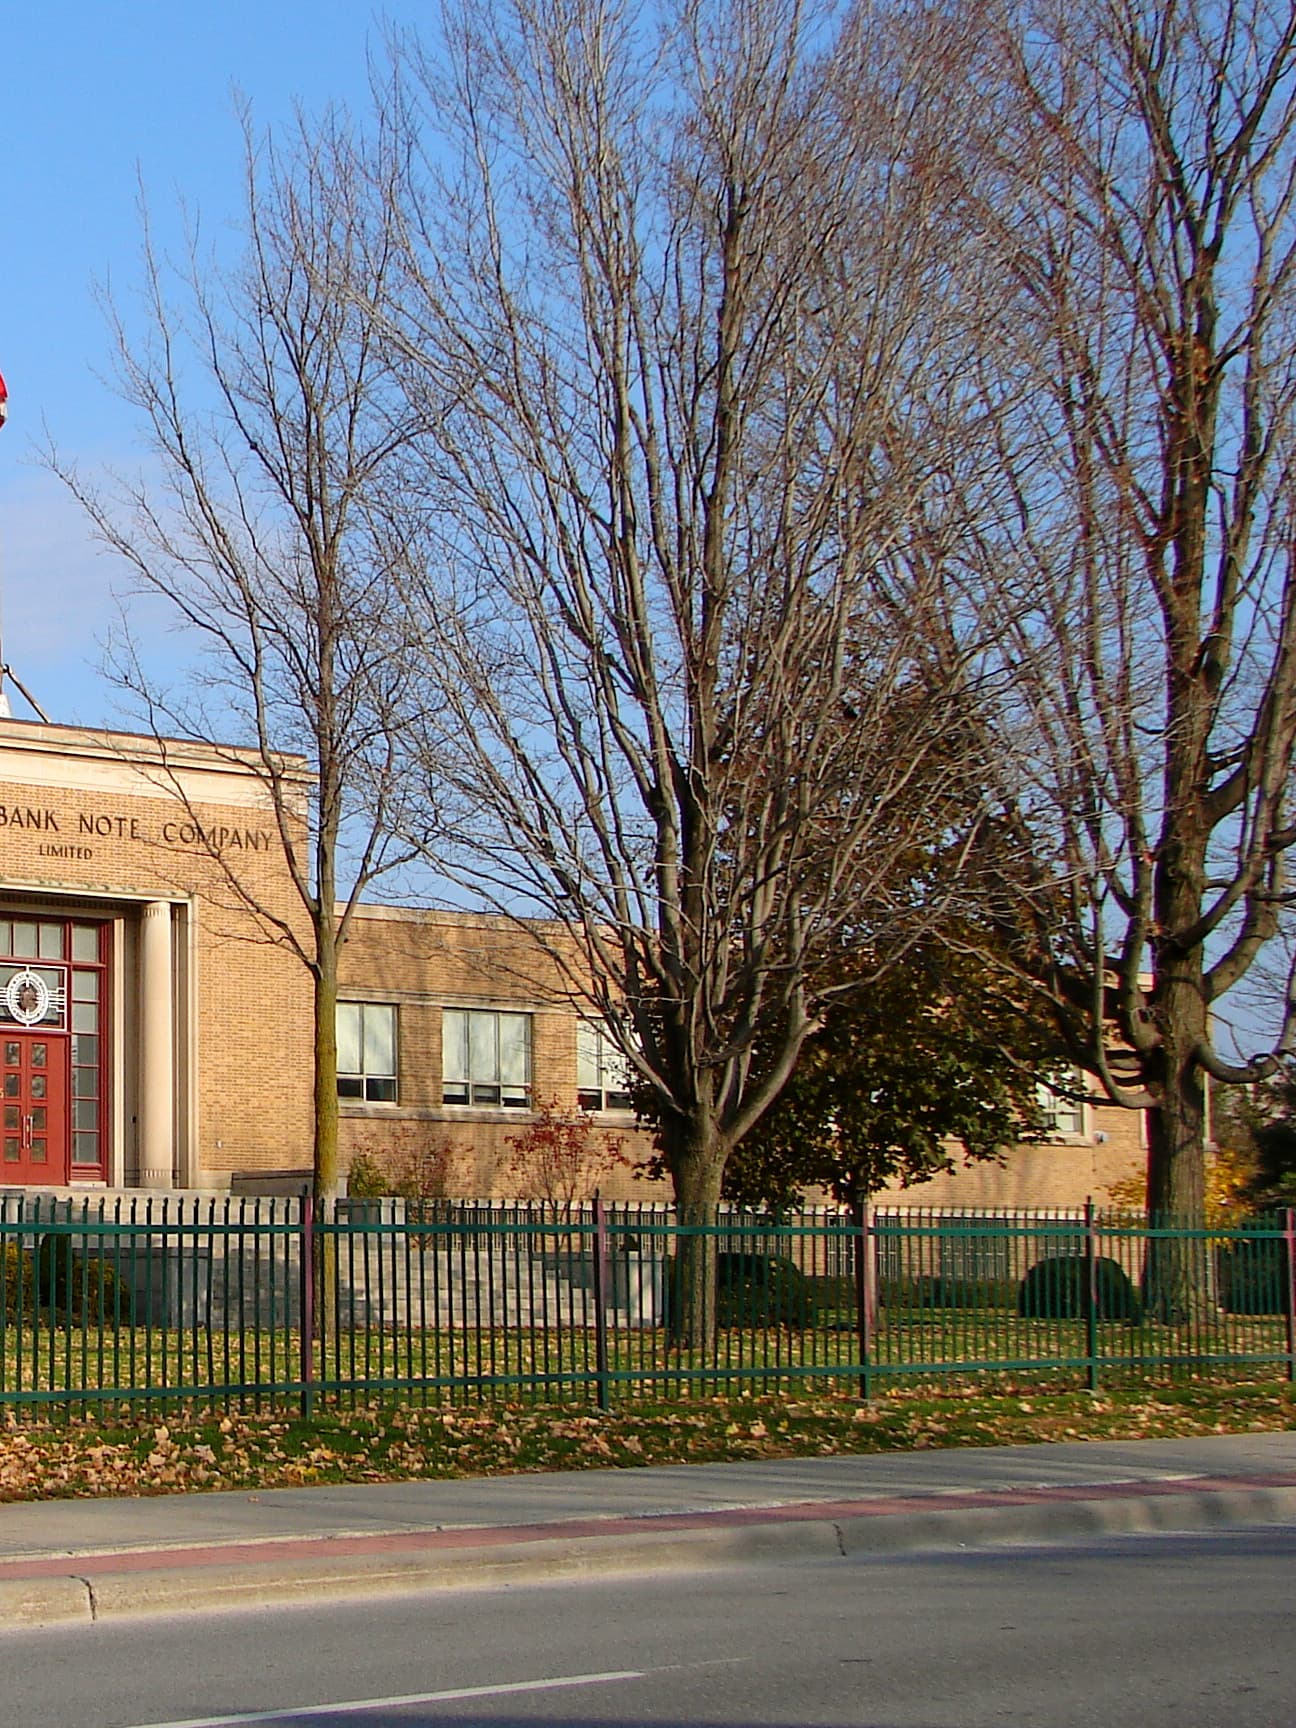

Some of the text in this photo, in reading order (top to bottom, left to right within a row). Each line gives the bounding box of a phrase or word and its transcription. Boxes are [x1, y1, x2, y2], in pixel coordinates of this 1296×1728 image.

[79, 813, 142, 840] NOTE
[162, 822, 273, 851] COMPANY
[39, 843, 93, 860] LIMITED
